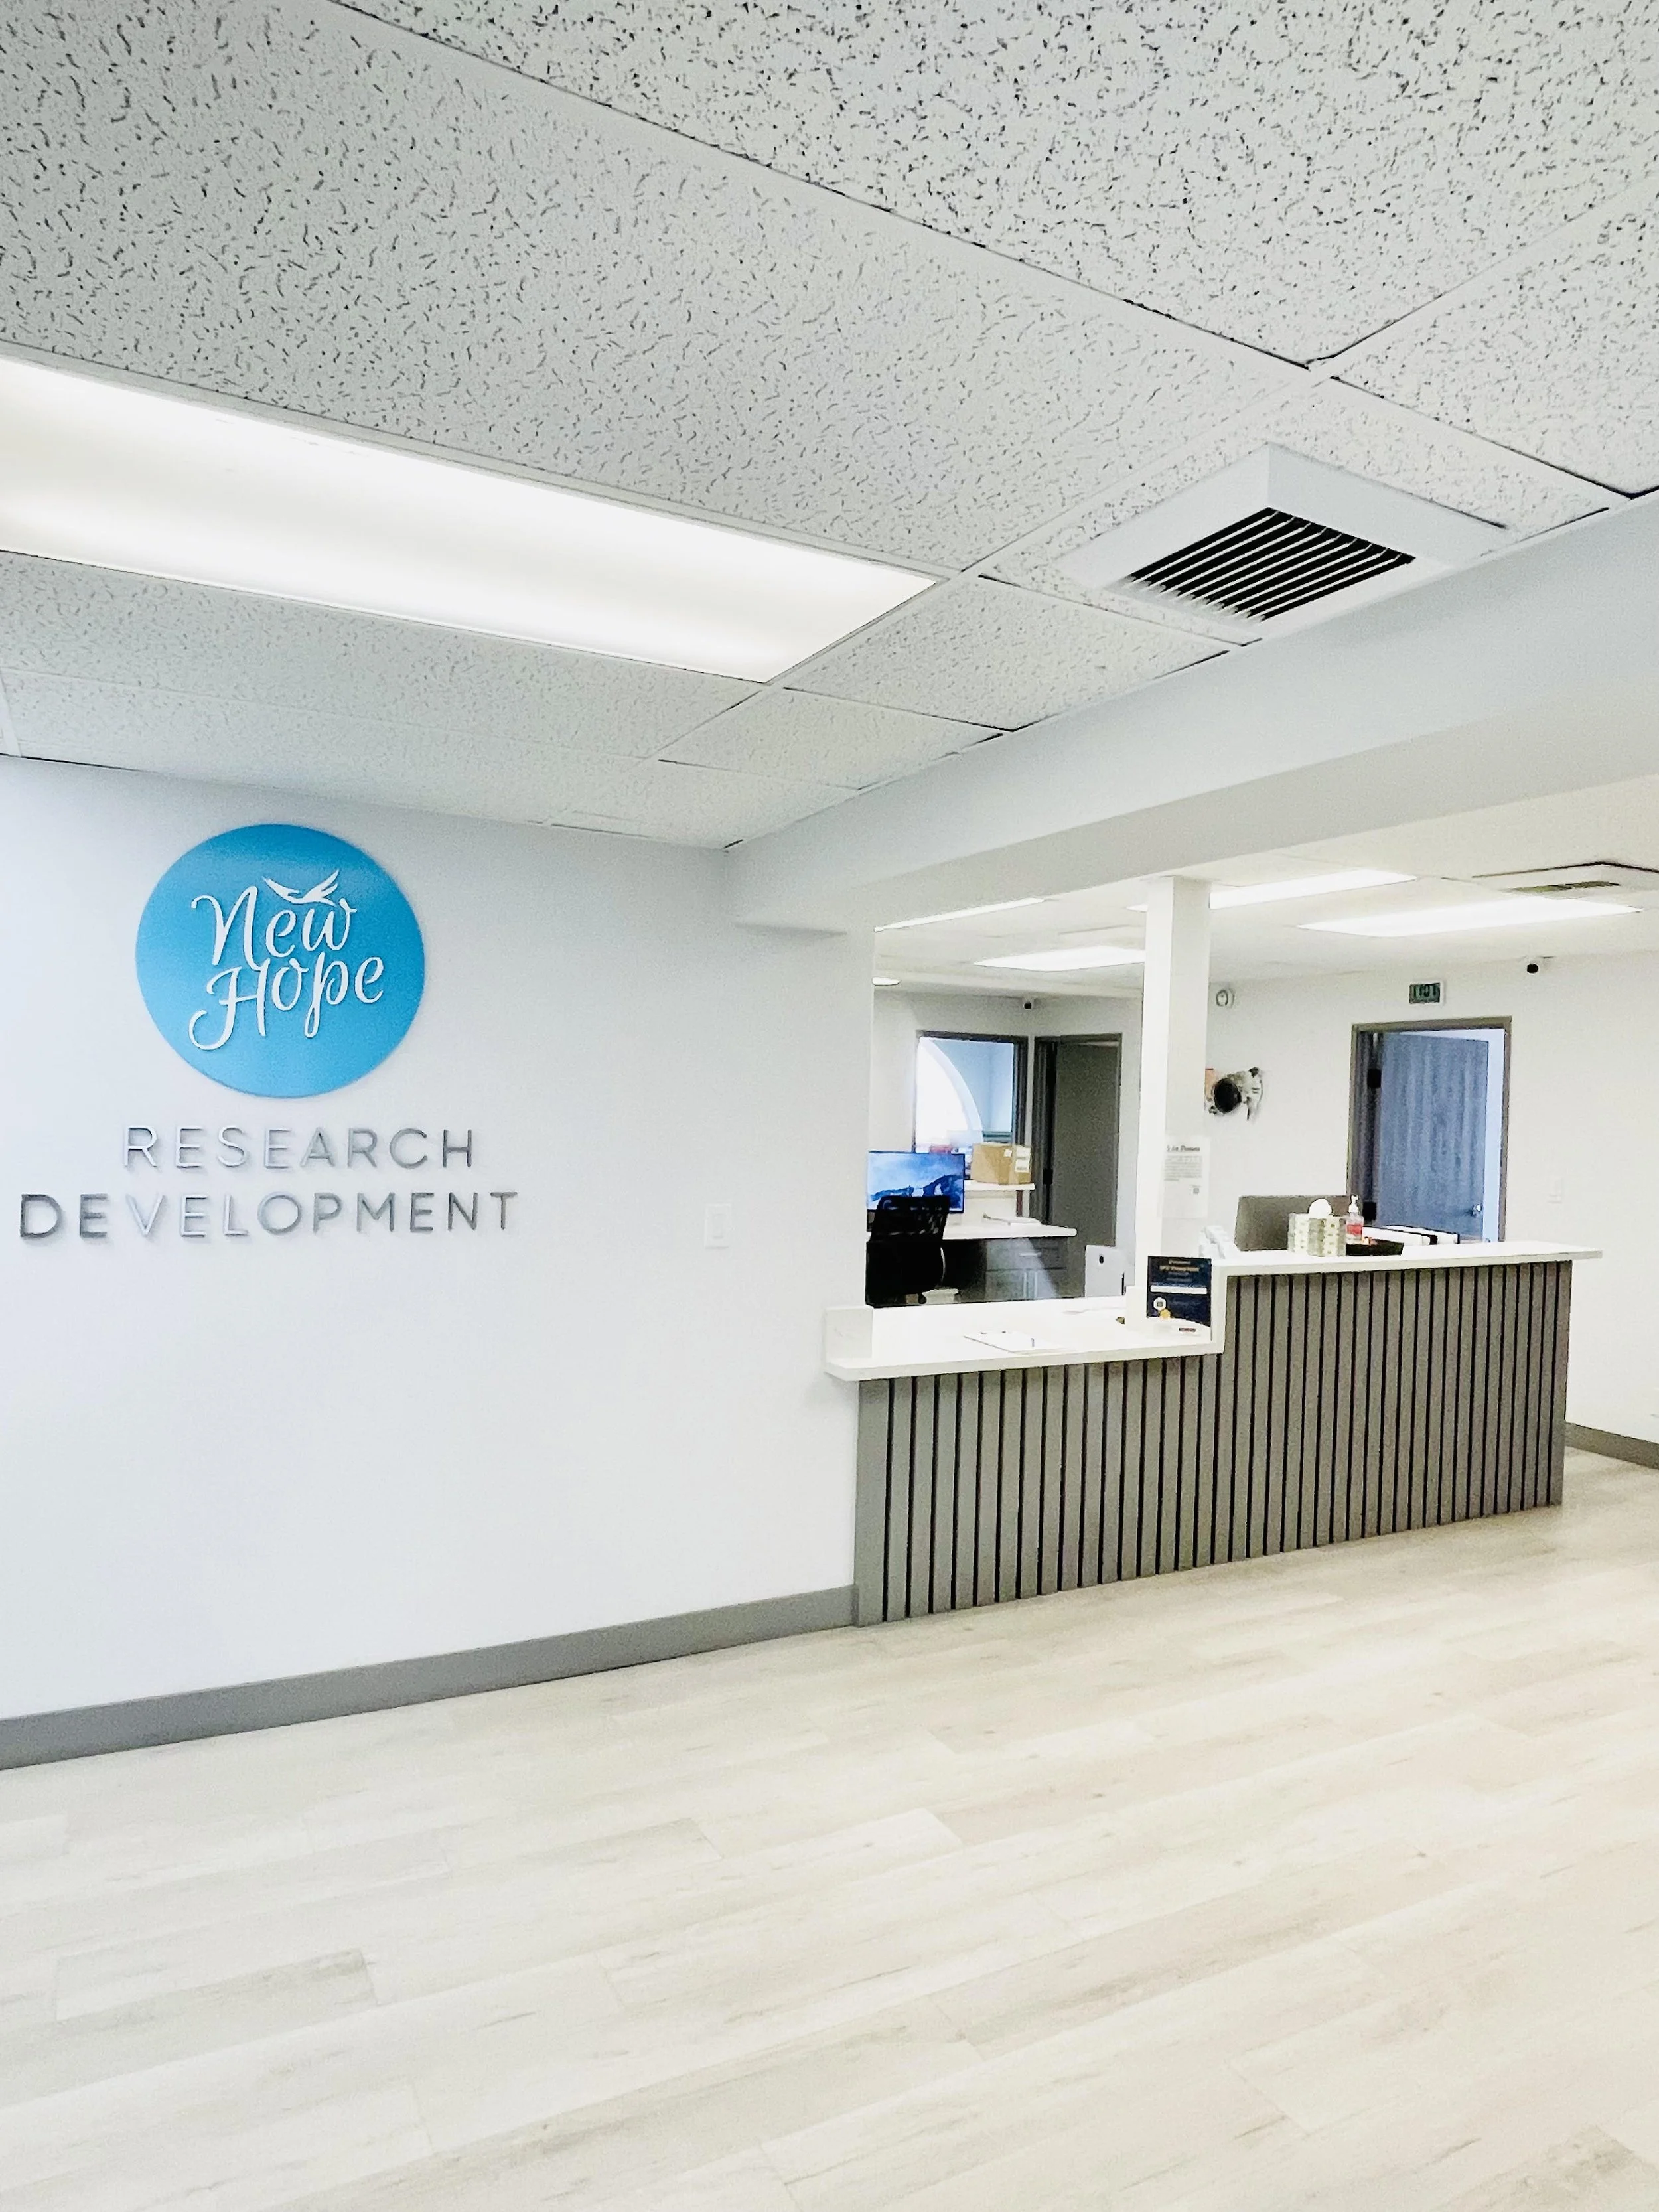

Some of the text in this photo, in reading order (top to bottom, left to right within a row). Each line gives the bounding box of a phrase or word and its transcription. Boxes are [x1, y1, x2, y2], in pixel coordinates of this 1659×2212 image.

[191, 885, 358, 971] New
[188, 952, 384, 1050] Hope
[123, 1125, 472, 1169] RESEARCH
[20, 1192, 518, 1238] DEVELOPMENT
